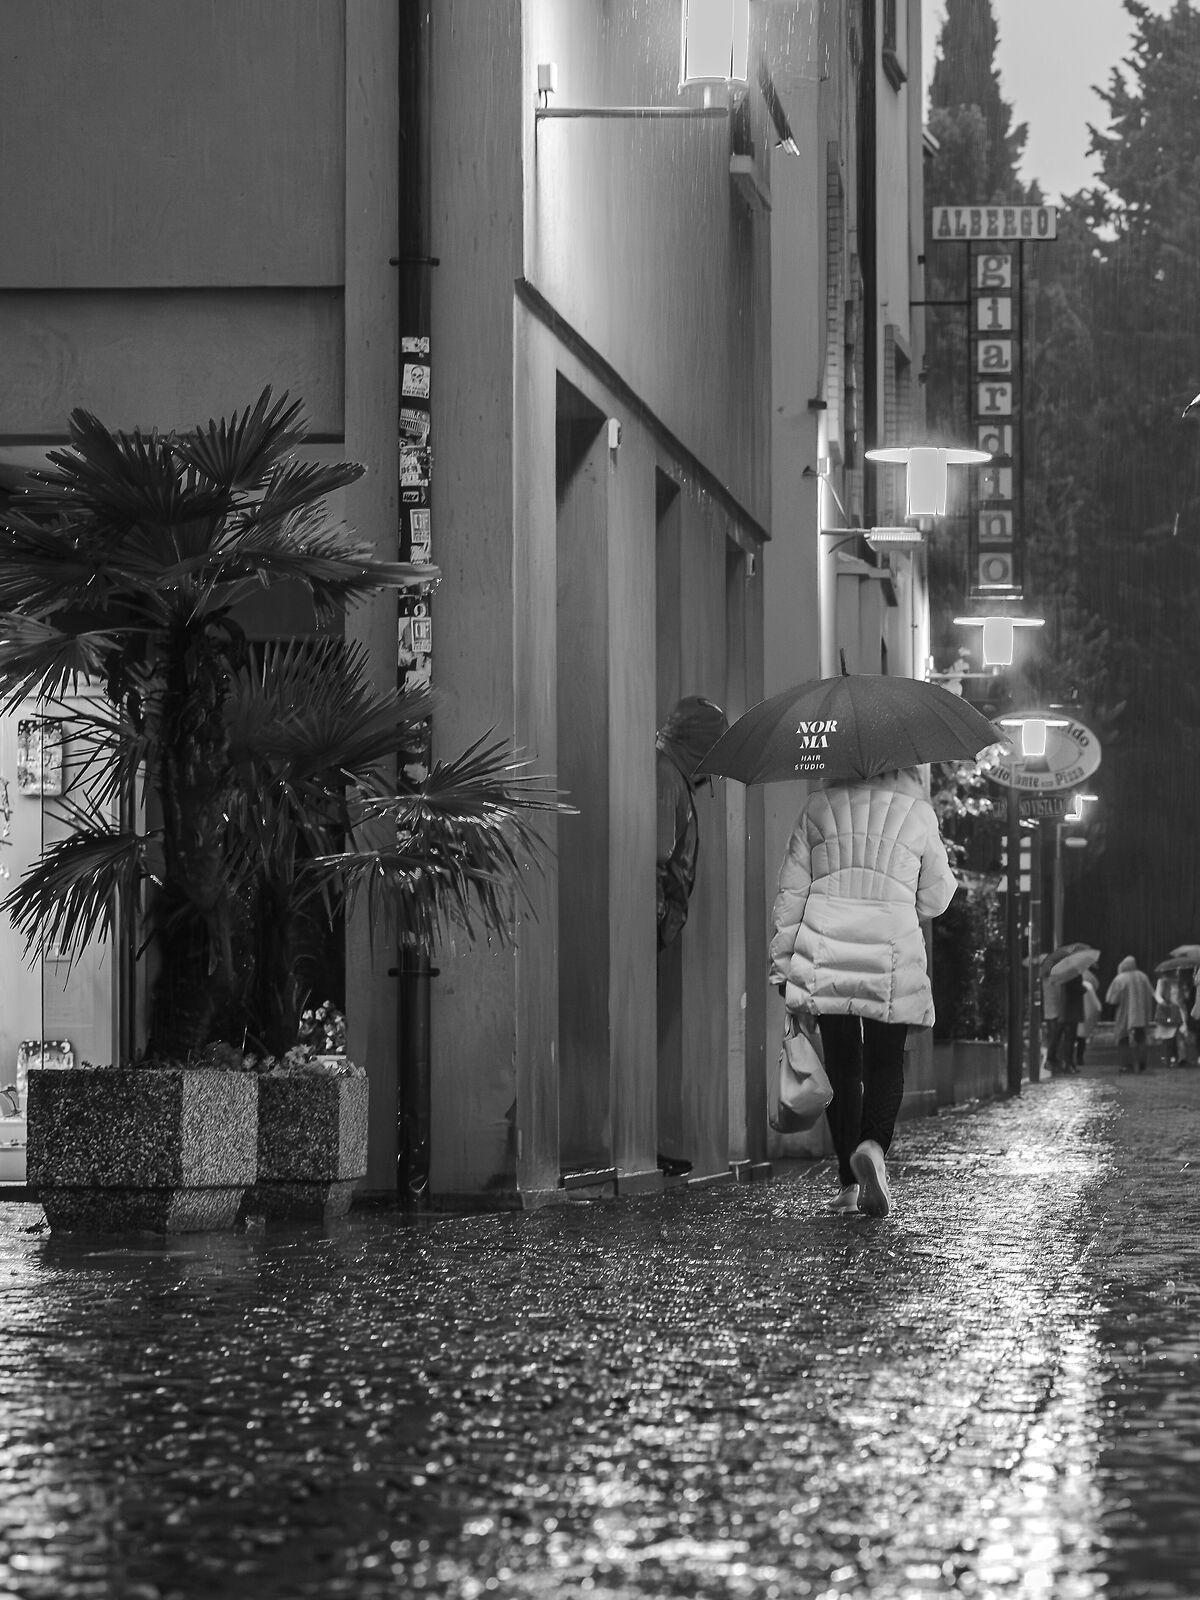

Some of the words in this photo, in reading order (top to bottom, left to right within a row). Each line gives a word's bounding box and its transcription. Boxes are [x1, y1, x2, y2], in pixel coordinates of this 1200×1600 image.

[938, 208, 1049, 237] ALBERGO
[980, 256, 1009, 582] giardino
[795, 720, 838, 734] NOR
[799, 734, 831, 749] MA
[800, 754, 821, 762] HAIR
[794, 763, 825, 771] STUDIO
